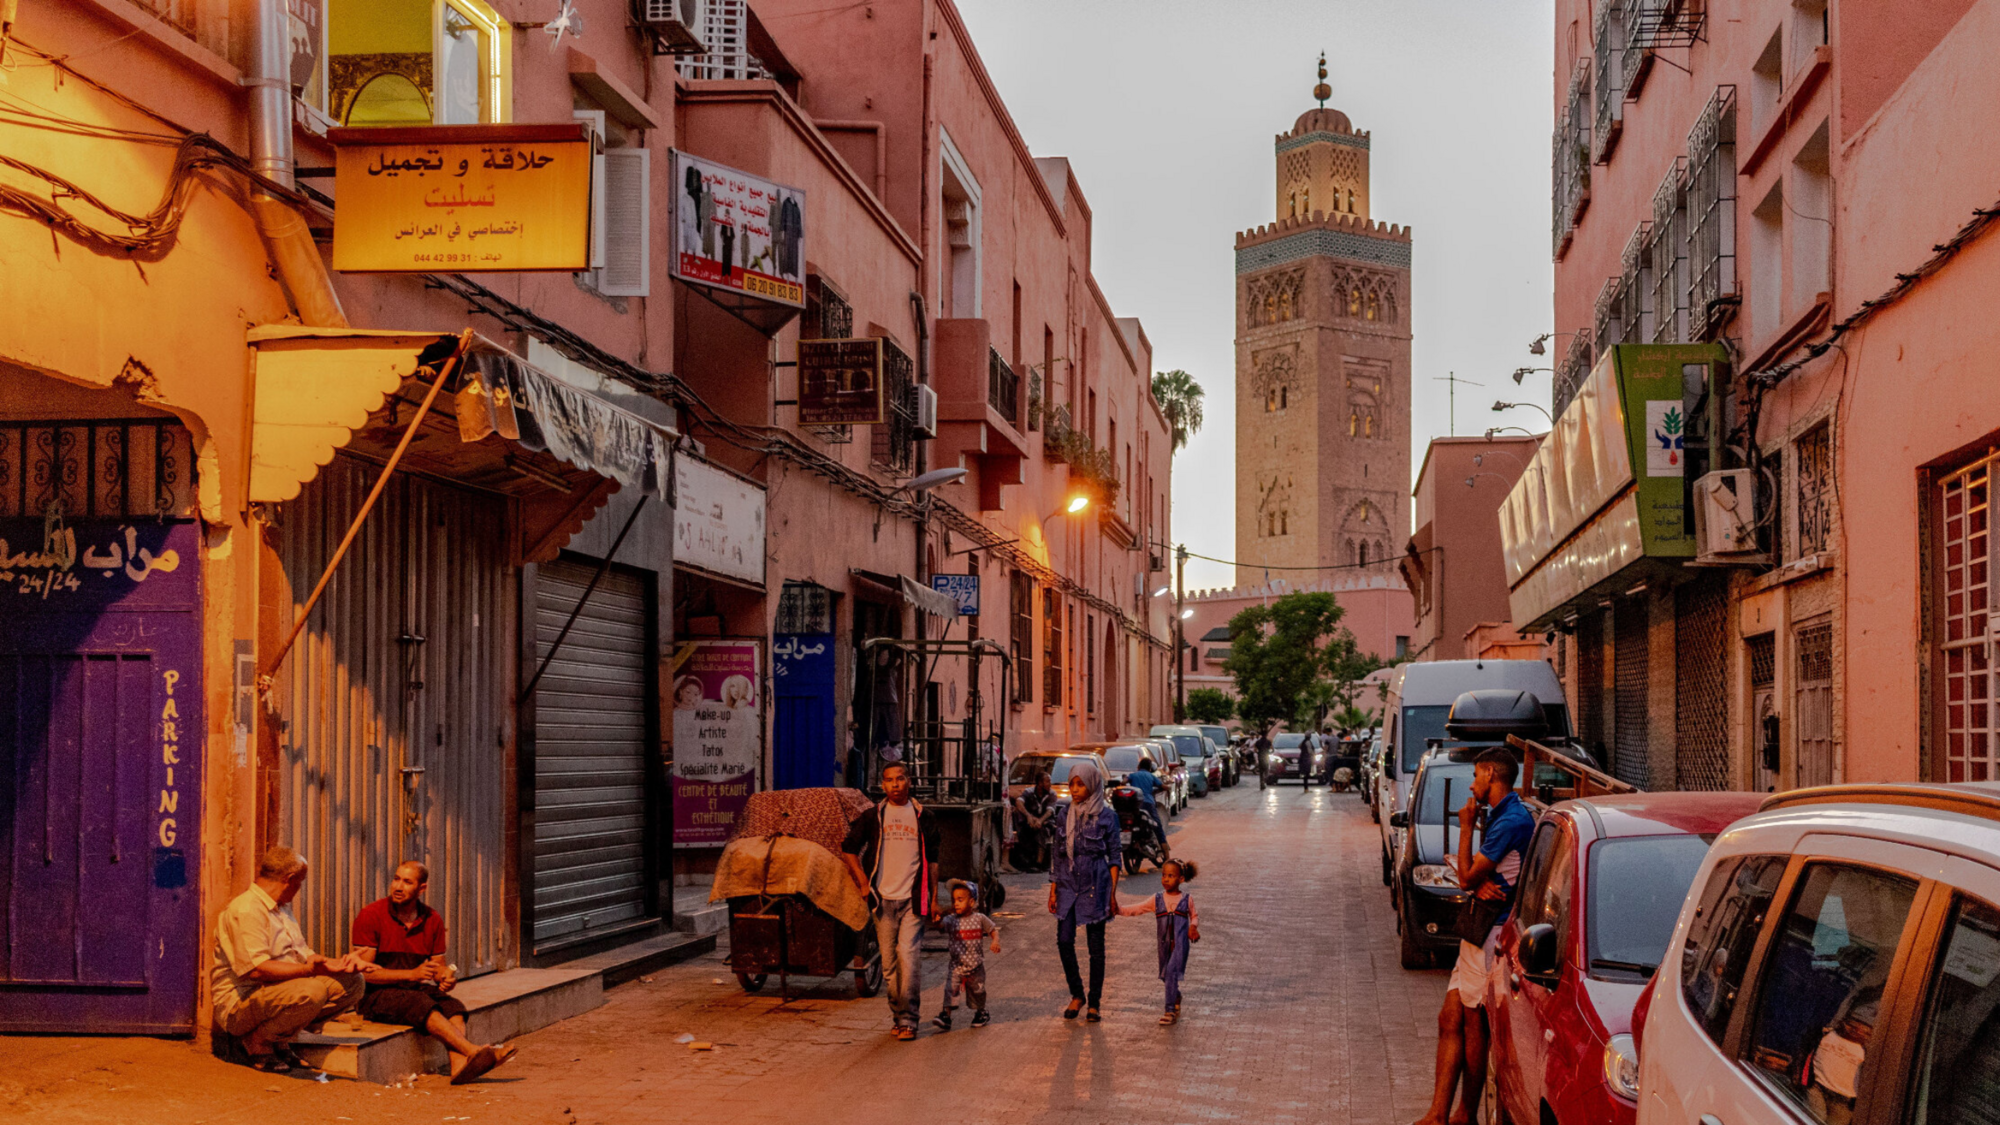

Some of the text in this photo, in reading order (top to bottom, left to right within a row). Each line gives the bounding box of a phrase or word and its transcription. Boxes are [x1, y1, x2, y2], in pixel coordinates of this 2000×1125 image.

[368, 148, 554, 177] حلاقة و تجميل
[447, 222, 461, 242] في
[414, 253, 431, 262] 044
[433, 253, 444, 262] 42
[447, 253, 458, 262] 99
[460, 253, 471, 262] 31
[747, 276, 756, 291] 06
[758, 279, 767, 293] 20
[769, 282, 776, 296] 91
[19, 570, 81, 600] 24/24
[934, 576, 949, 591] P
[950, 576, 977, 592] 24/24
[774, 636, 825, 660] مرآب
[694, 708, 731, 723] Make-up
[698, 726, 727, 739] Artiste
[702, 744, 723, 757] Tatos
[159, 670, 180, 848] PARKING
[680, 763, 718, 776] Spécialité
[678, 784, 705, 797] CENTRE
[707, 784, 717, 797] DE
[709, 798, 717, 810] ET
